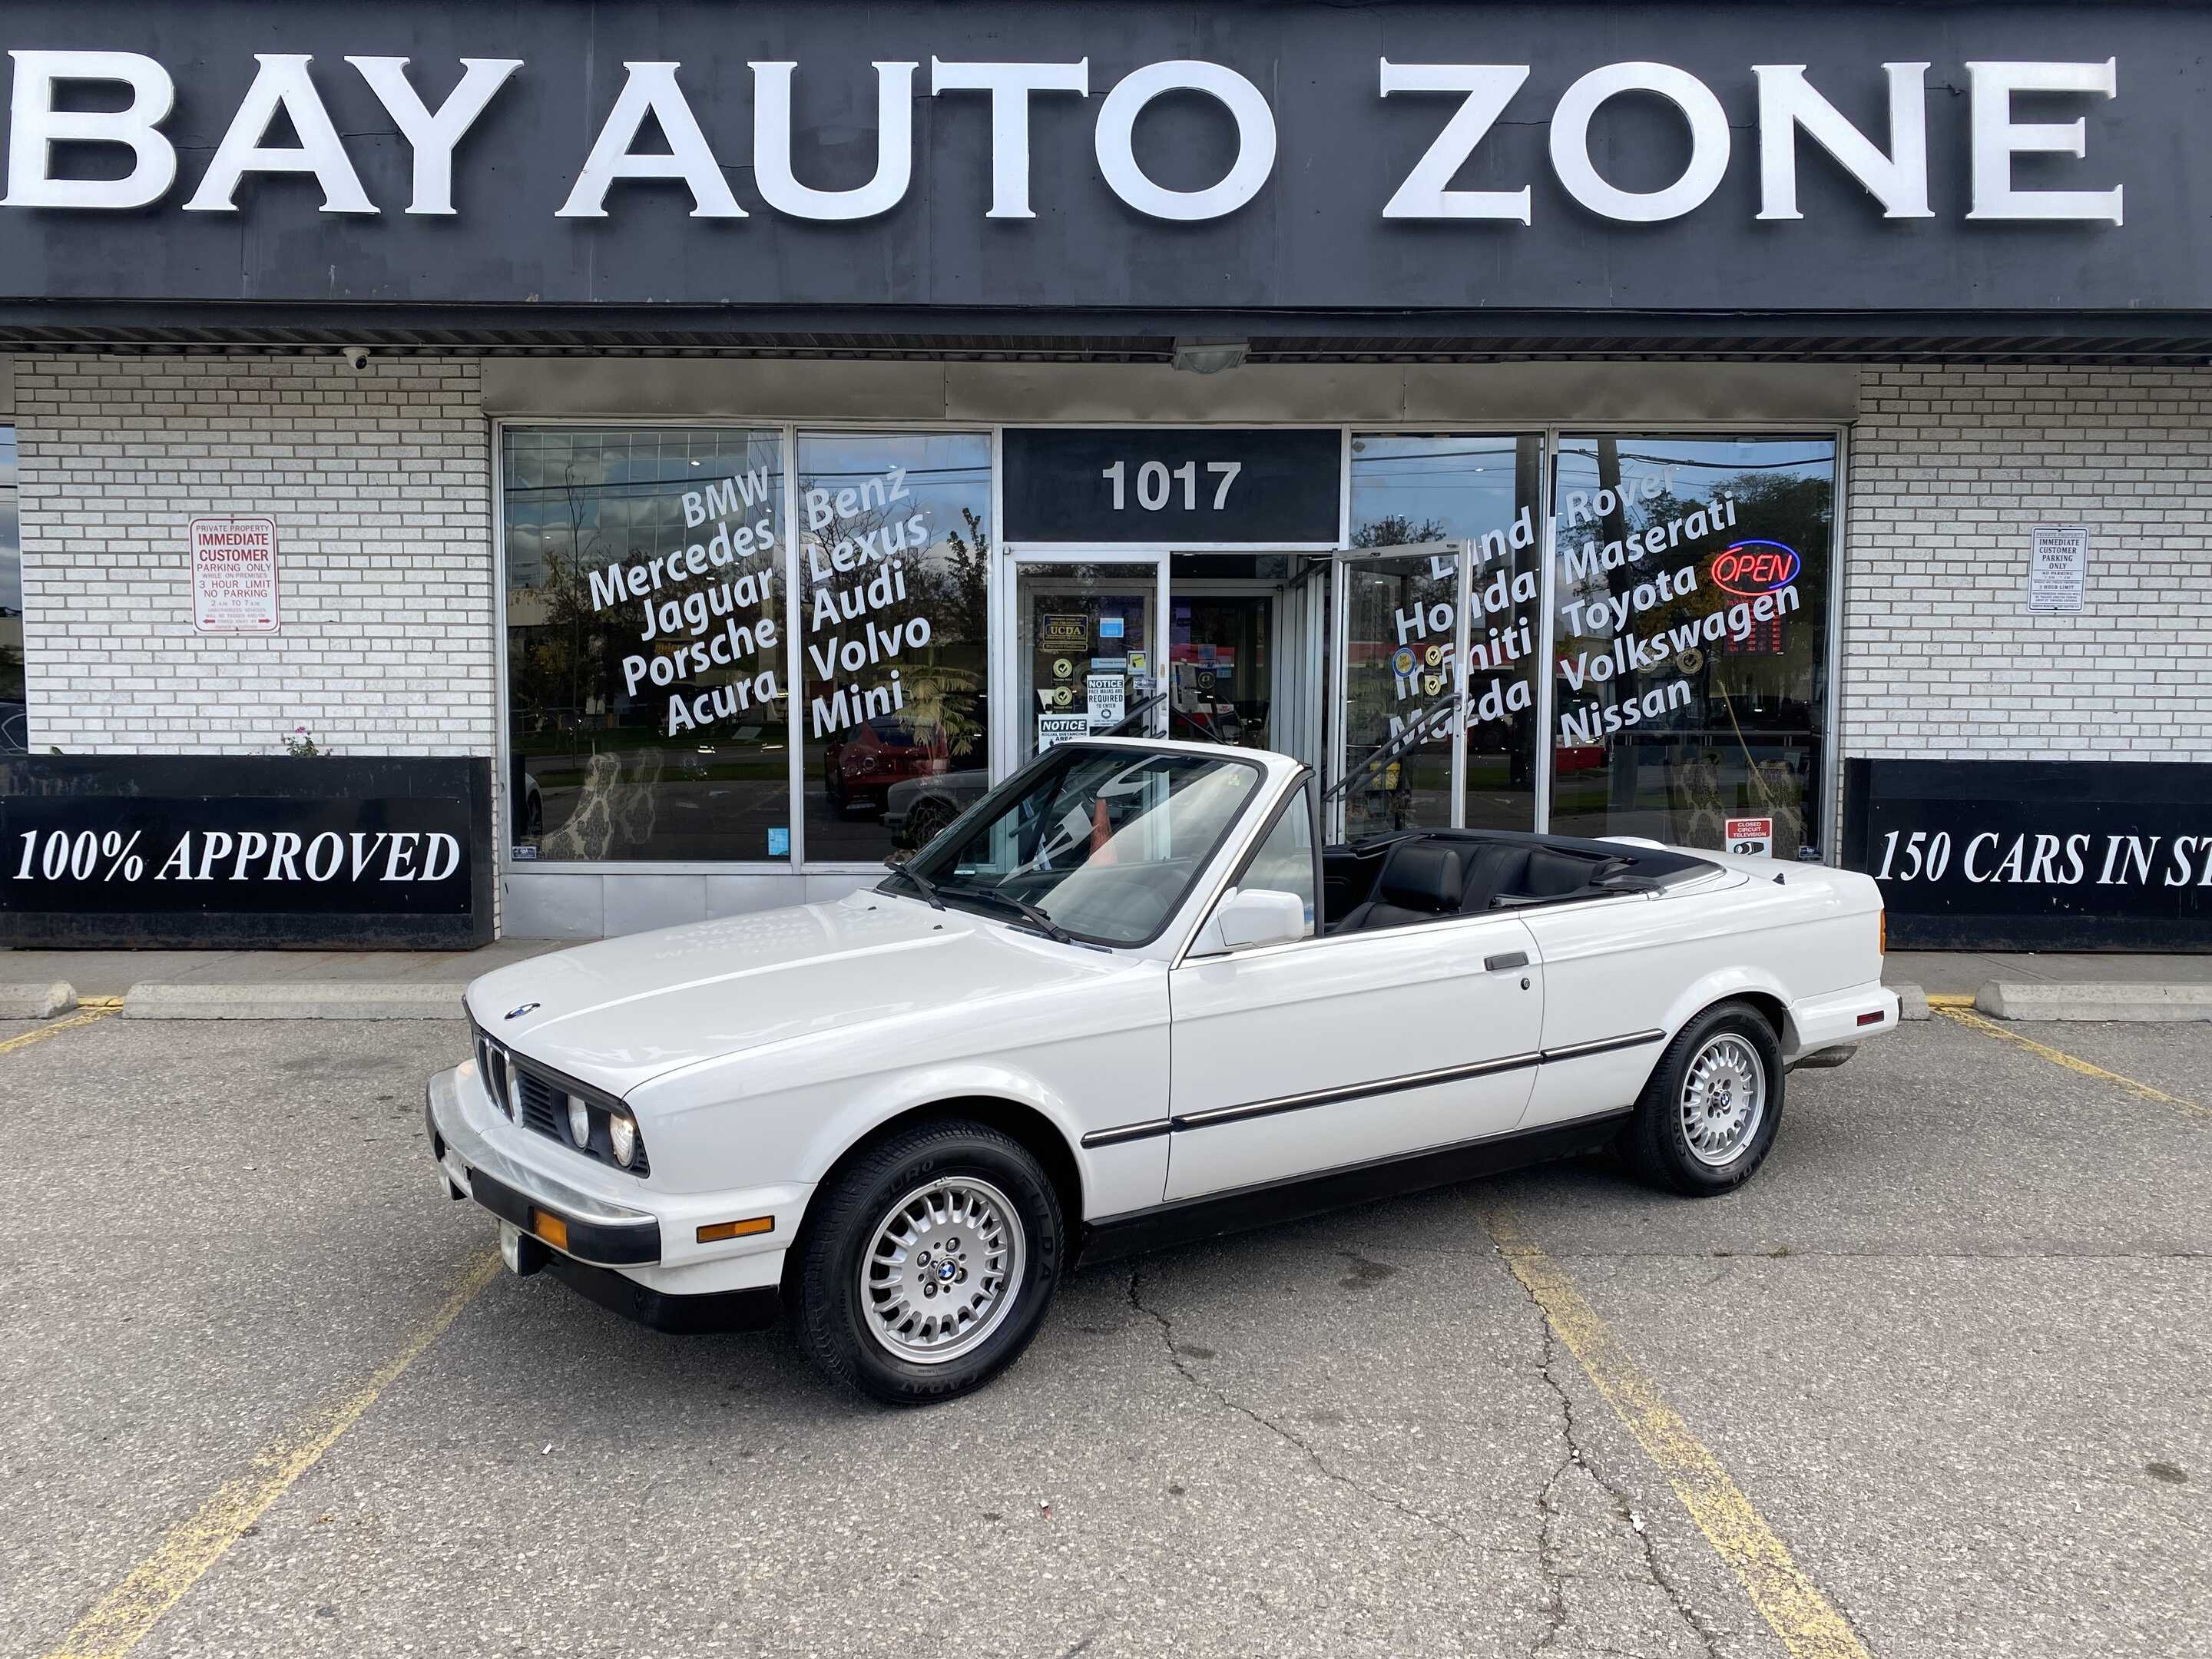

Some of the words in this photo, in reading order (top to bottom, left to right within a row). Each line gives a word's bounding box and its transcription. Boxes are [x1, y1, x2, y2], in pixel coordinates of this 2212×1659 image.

[0, 51, 524, 214] BAY
[555, 55, 1276, 220] AUTO
[1380, 56, 2124, 226] ZONE
[681, 465, 769, 528] BMW
[1102, 461, 1241, 511] 1017
[198, 533, 269, 545] IMMEDIATE
[199, 549, 269, 561] CUSTOMER
[588, 517, 774, 612] Mercedes
[805, 467, 909, 532] Benz
[808, 512, 927, 583] Lexus
[1430, 505, 1535, 581] Lnd
[1565, 465, 1674, 528] Rover
[1564, 491, 1736, 585] Maserati
[197, 563, 240, 572] PARKING
[247, 563, 271, 572] ONLY
[199, 580, 205, 588] 3
[211, 580, 239, 588] HOUR
[245, 580, 271, 588] LIMIT
[204, 589, 217, 598] NO
[224, 589, 267, 598] PARKING
[812, 561, 906, 633] Audi
[1717, 554, 1793, 582] OPEN
[641, 568, 773, 642] Jaguar
[1051, 626, 1081, 635] UCDA
[1562, 565, 1697, 638] Toyota
[622, 618, 778, 696] Porsche
[808, 616, 931, 681] Volvo
[1395, 617, 1532, 700] Infniti
[1559, 584, 1800, 691] Volkswagen
[668, 671, 778, 737] Acura
[812, 669, 905, 739] Mini
[1042, 720, 1085, 730] NOTICE
[1089, 694, 1123, 703] REQUIRED
[1560, 679, 1691, 749] Nissan
[12, 830, 144, 882] 100%
[154, 831, 460, 882] APPROVED
[1875, 830, 1951, 882] 150
[1964, 833, 2091, 884] CARS
[2097, 836, 2161, 885] IN
